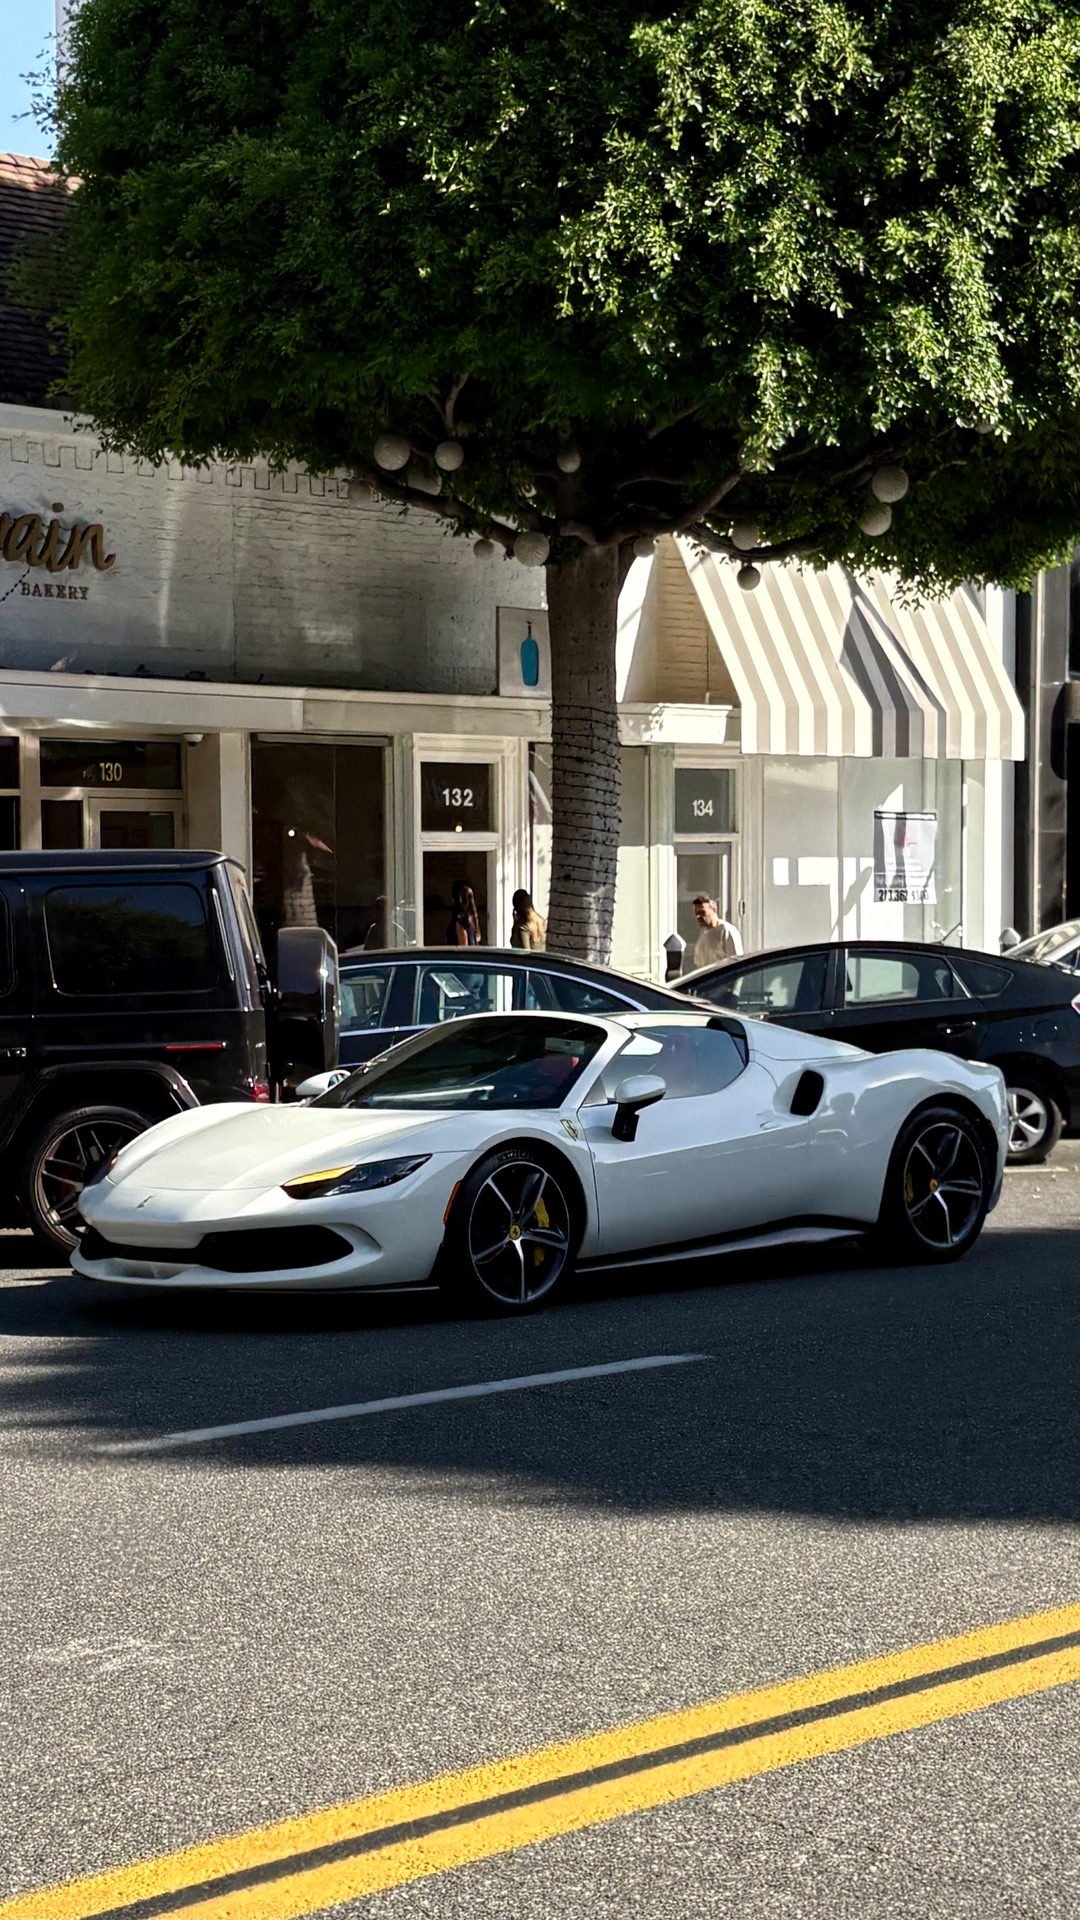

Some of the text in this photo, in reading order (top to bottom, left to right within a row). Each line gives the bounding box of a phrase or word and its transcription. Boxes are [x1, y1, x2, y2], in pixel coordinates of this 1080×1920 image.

[20, 582, 89, 600] BAKERY
[99, 762, 123, 782] 130
[442, 788, 474, 807] 132
[692, 799, 714, 817] 134
